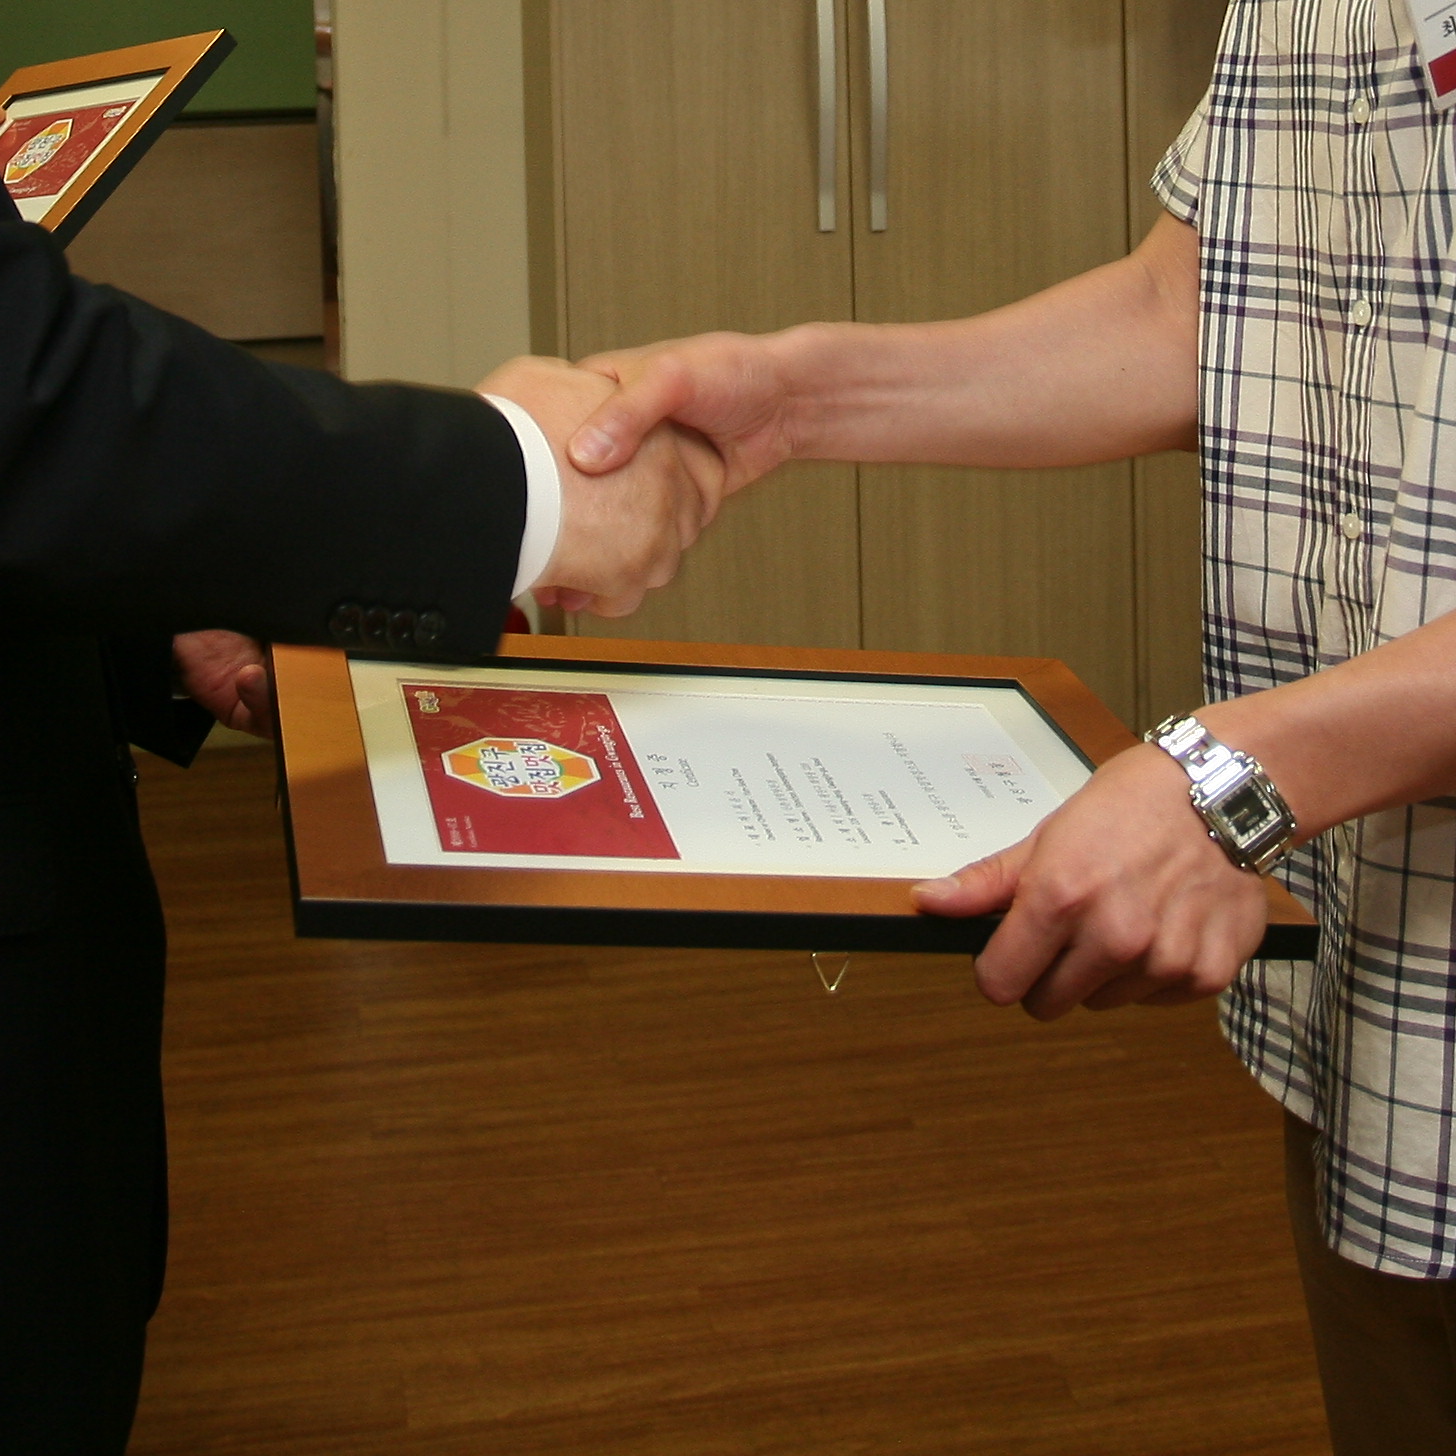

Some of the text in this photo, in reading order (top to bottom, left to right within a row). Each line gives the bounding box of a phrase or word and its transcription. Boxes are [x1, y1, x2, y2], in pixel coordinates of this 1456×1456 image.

[480, 747, 521, 789] 광진구
[516, 741, 564, 796] 맛집멋집
[628, 803, 645, 819] Best
